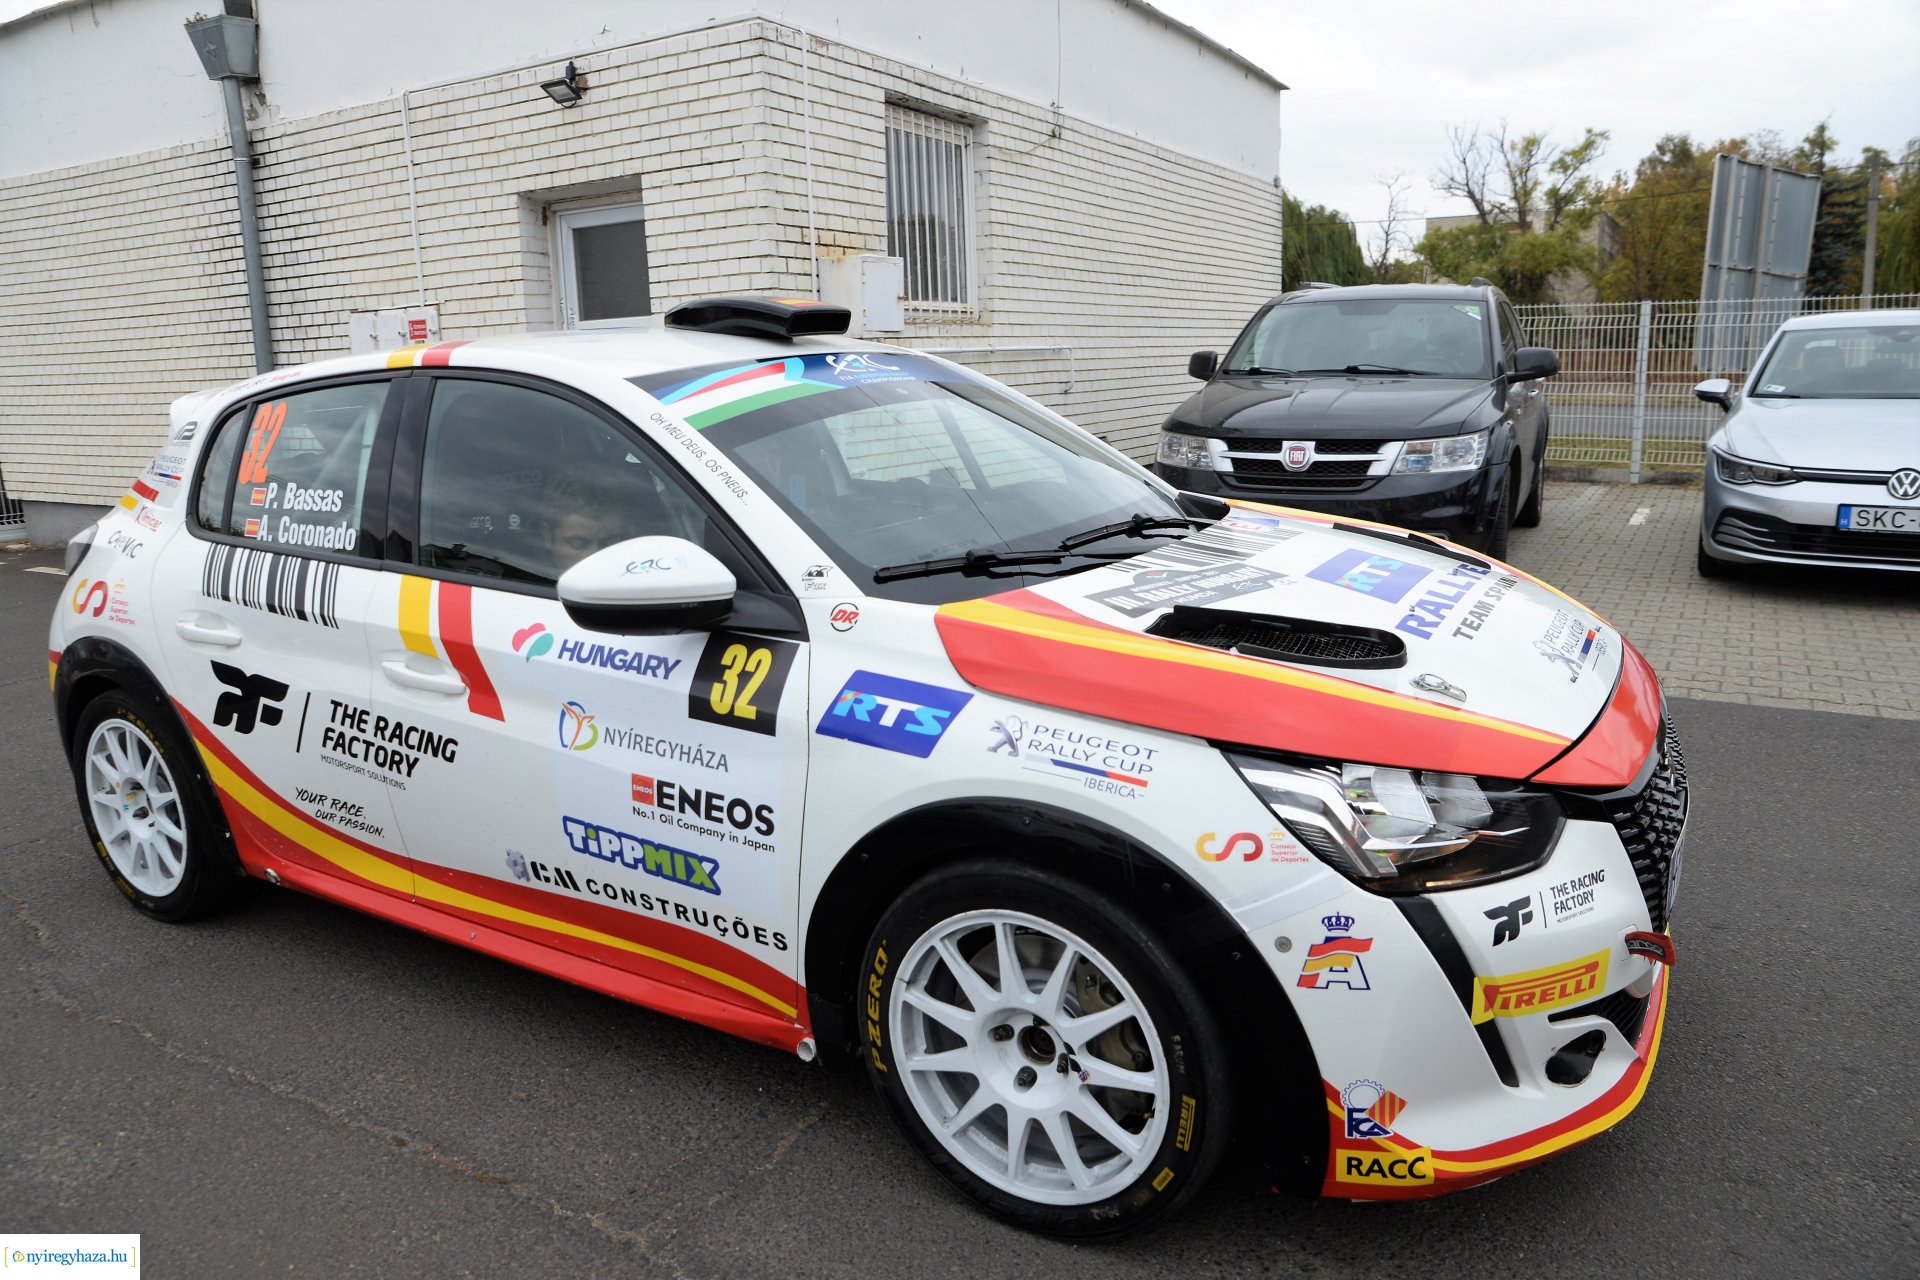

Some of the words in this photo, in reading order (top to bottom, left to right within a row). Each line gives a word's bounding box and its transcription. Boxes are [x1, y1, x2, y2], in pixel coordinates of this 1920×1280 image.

[239, 402, 288, 485] 32
[650, 412, 668, 425] OH
[663, 423, 686, 440] MEU
[681, 438, 707, 461] DEUS,
[705, 459, 722, 473] OS
[1290, 450, 1305, 462] FIAT
[264, 482, 278, 509] P.
[283, 482, 344, 513] Bassas
[256, 514, 273, 542] A.
[278, 516, 357, 551] Coronado
[1856, 509, 1920, 529] SKC-
[1335, 555, 1404, 592] RTS
[1136, 584, 1198, 602] RALLY
[1395, 563, 1491, 640] RALLYE
[831, 609, 860, 624] DR
[1452, 600, 1495, 640] TEAM
[1544, 609, 1568, 644] PEUGEOT
[558, 639, 682, 680] HUNGARY
[710, 644, 772, 720] 32
[331, 699, 370, 733] THE
[374, 715, 459, 763] RACING
[832, 689, 951, 736] RTS
[322, 727, 419, 778] FACTORY
[604, 726, 729, 773] NYÍREGYHÁZA
[1028, 739, 1097, 762] RALLY
[1103, 756, 1153, 774] CUP
[1033, 724, 1159, 760] PEUGEOT
[321, 754, 366, 776] MOTORSPORT
[367, 770, 407, 790] SOLUTIONS
[633, 783, 653, 794] ENEOS
[1083, 777, 1136, 799] IBERICA
[295, 787, 328, 806] YOUR
[331, 798, 367, 819] RACE.
[656, 779, 775, 836] ENEOS
[315, 809, 337, 823] OUR
[338, 815, 385, 838] PASSION.
[632, 806, 656, 820] No.1
[660, 814, 674, 826] Oil
[676, 819, 726, 842] Company
[729, 831, 739, 844] in
[742, 837, 775, 853] Japan
[1550, 882, 1570, 899] THE
[1570, 869, 1605, 893] RACING
[1554, 889, 1594, 915] FACTORY
[586, 878, 788, 951] CONSTRUÇÕES
[868, 947, 888, 1047] ZERO
[1483, 960, 1600, 1013] PIRELLI
[871, 1048, 888, 1073] P
[1176, 1094, 1196, 1151] PIRELLI
[1346, 1156, 1426, 1180] RACC
